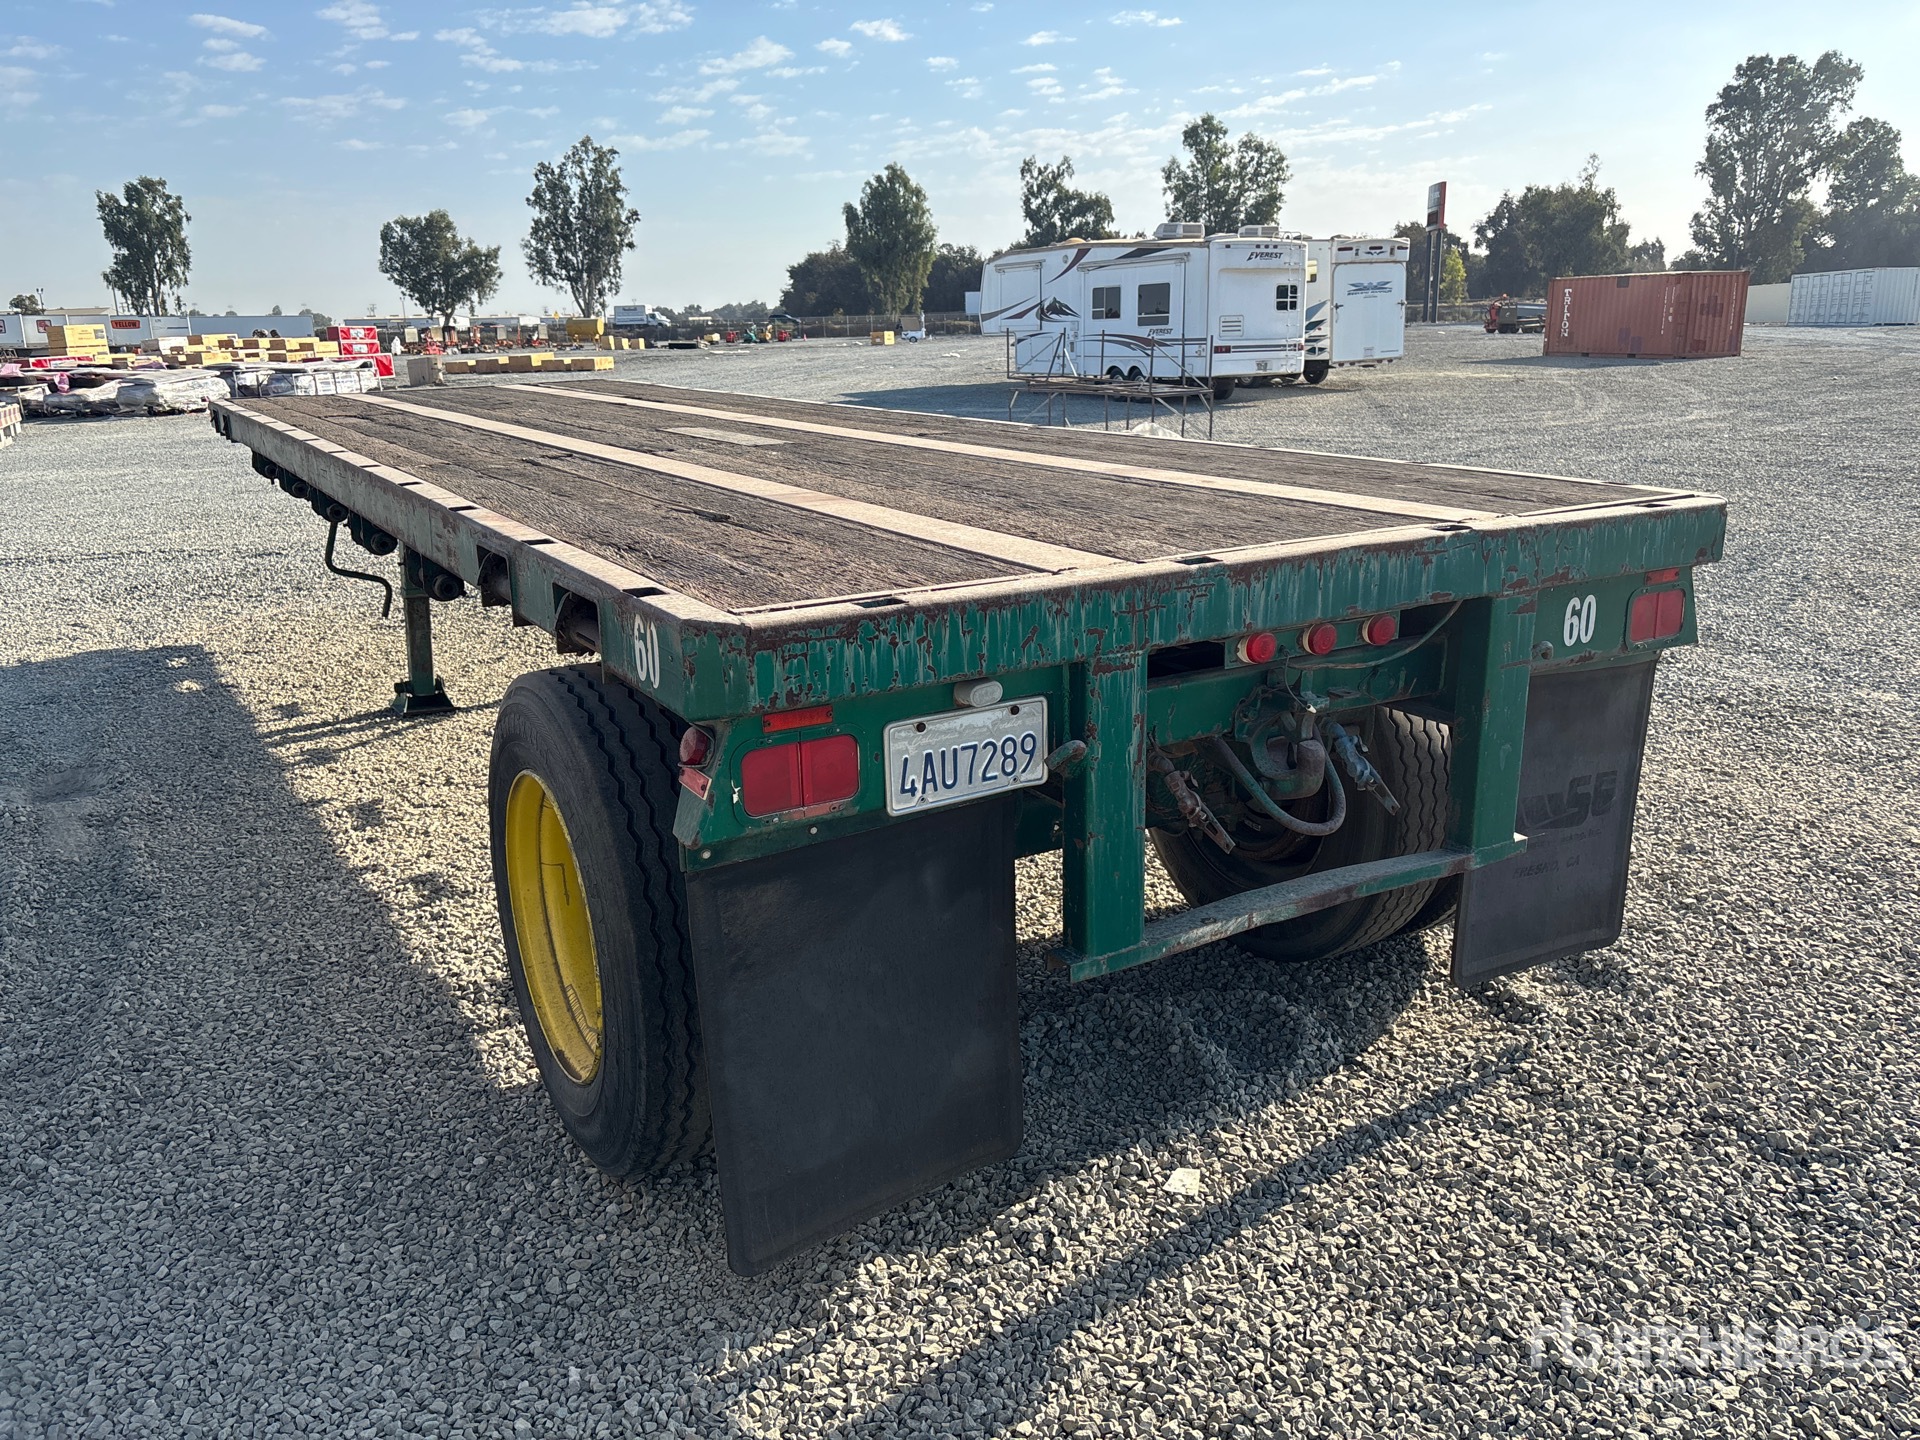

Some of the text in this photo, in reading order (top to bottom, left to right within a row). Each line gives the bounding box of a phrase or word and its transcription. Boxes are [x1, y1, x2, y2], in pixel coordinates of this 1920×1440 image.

[1246, 251, 1284, 261] EVEREST
[1147, 328, 1173, 337] EVEREST
[1560, 288, 1573, 337] TRITON
[1563, 594, 1597, 647] 60
[633, 613, 660, 689] 60
[900, 731, 1038, 798] 4AU7289
